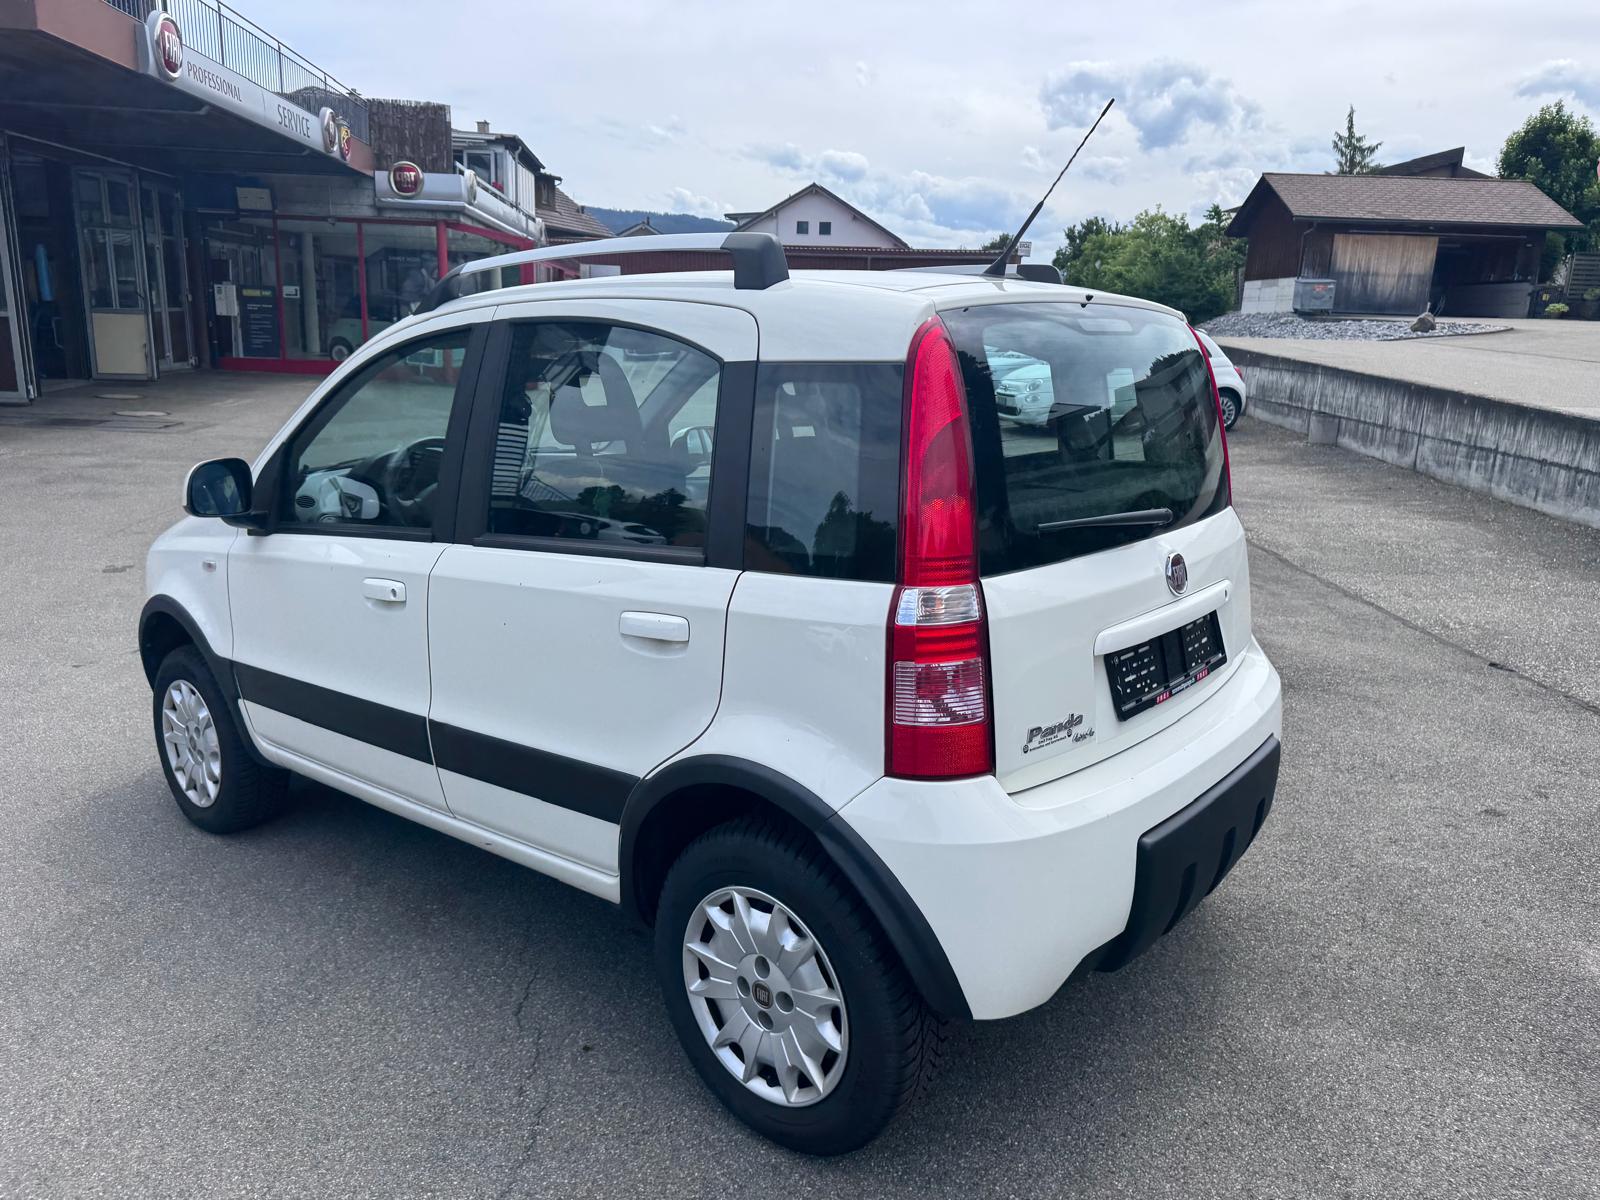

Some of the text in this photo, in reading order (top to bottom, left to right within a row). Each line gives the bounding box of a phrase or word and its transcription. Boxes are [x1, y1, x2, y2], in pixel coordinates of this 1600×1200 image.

[186, 60, 242, 102] PROFESSIONAL
[277, 103, 311, 138] SERVICE
[1026, 713, 1083, 744] Panda
